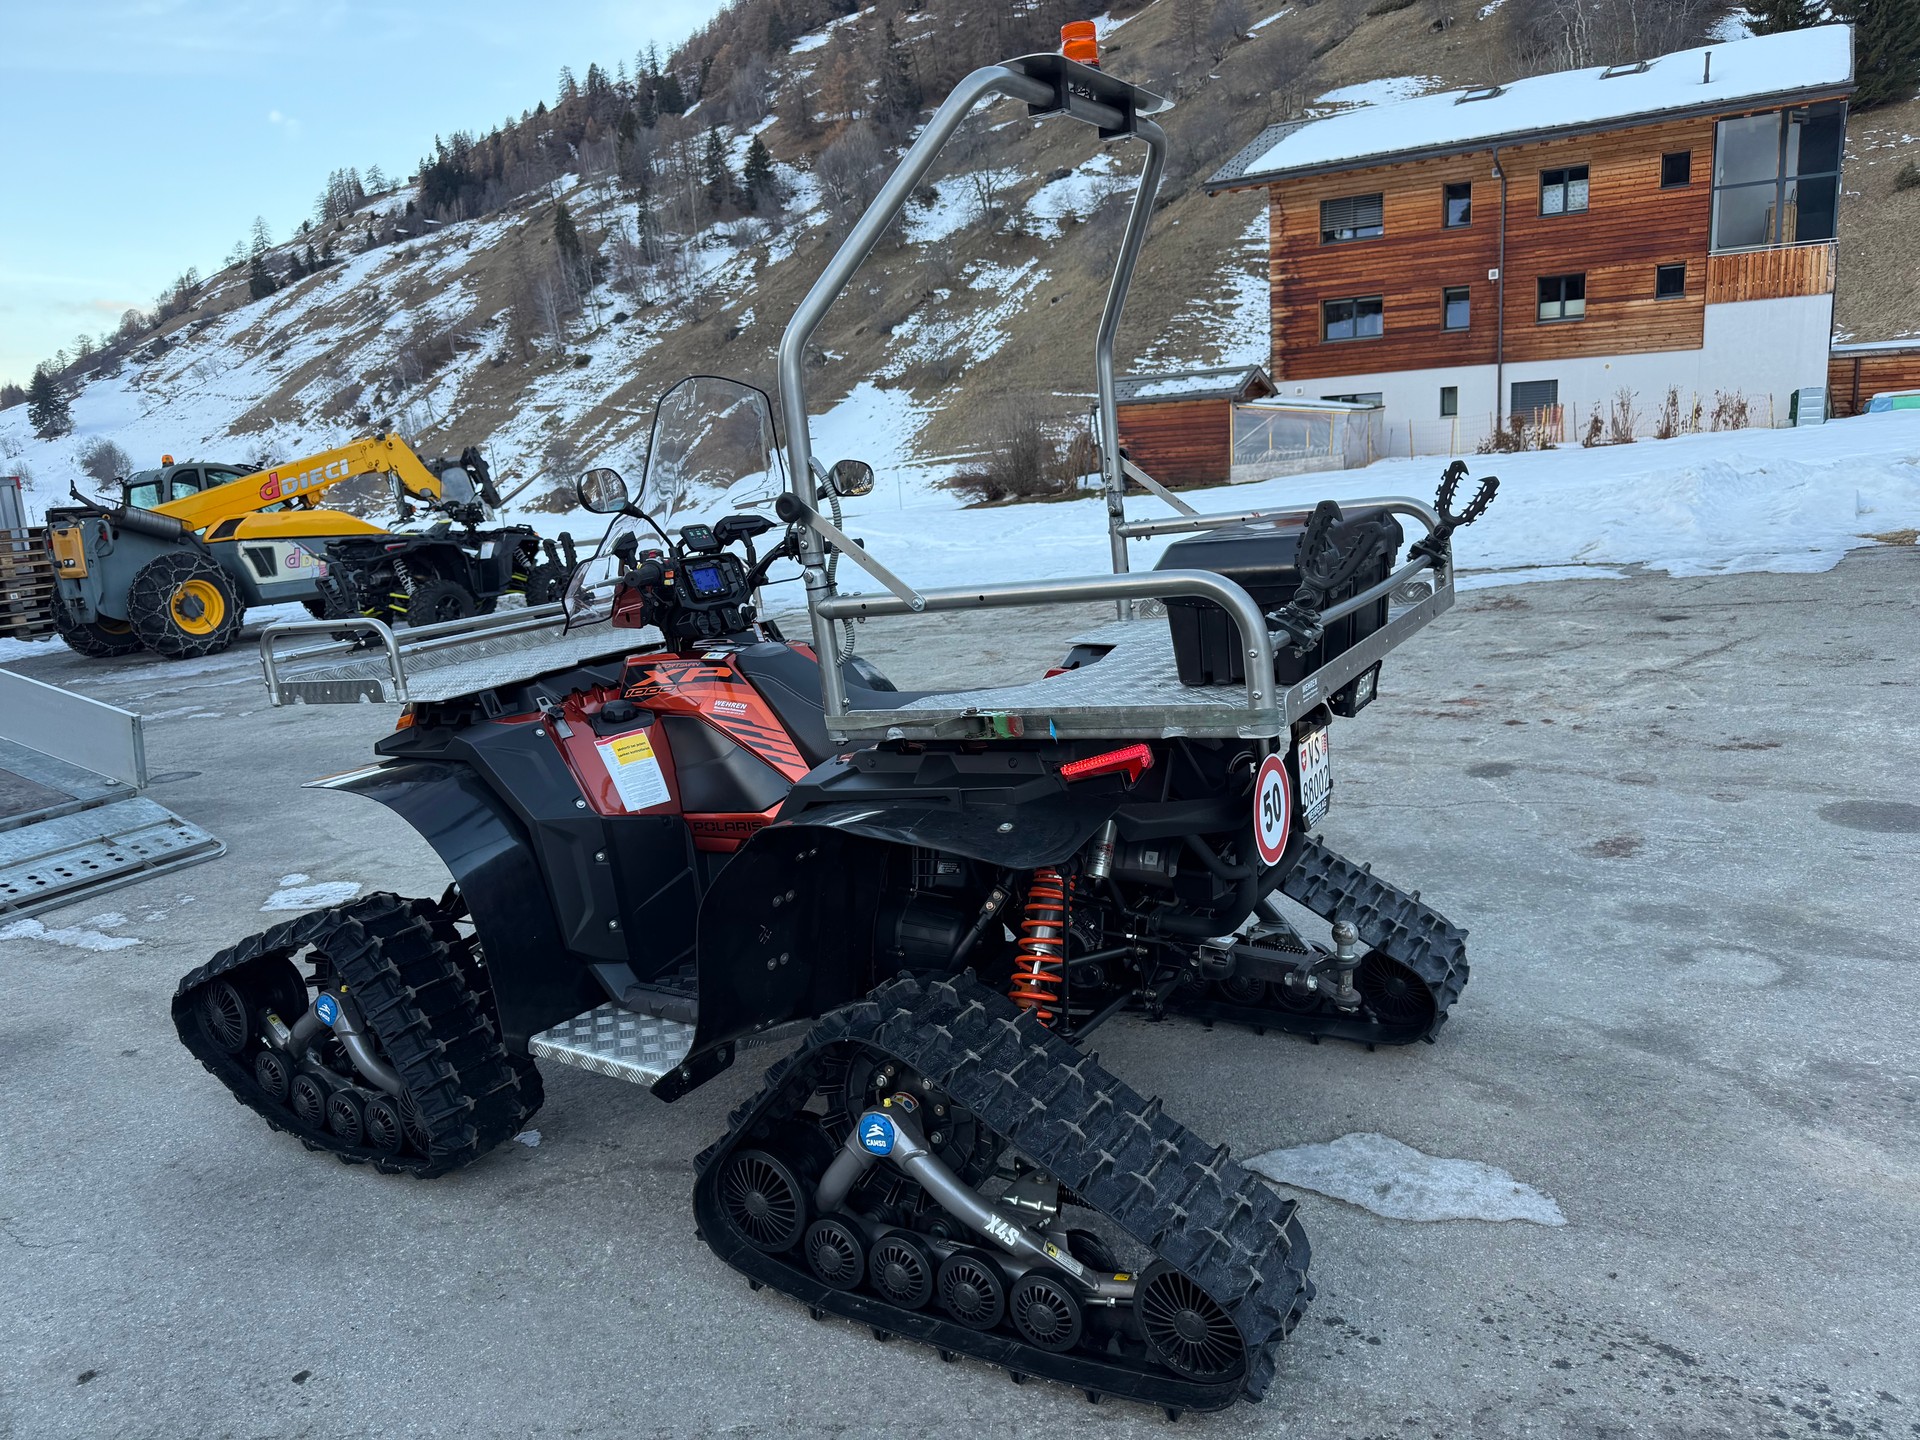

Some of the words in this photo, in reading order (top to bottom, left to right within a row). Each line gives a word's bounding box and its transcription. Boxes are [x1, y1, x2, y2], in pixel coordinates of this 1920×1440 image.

[631, 667, 733, 687] XP
[624, 685, 676, 698] 1000
[714, 700, 747, 709] WEHREN
[1308, 736, 1320, 769] VS
[1303, 765, 1330, 811] 88002
[1263, 783, 1281, 832] 50
[693, 821, 762, 832] POLARIS
[984, 1214, 1020, 1246] X4S
